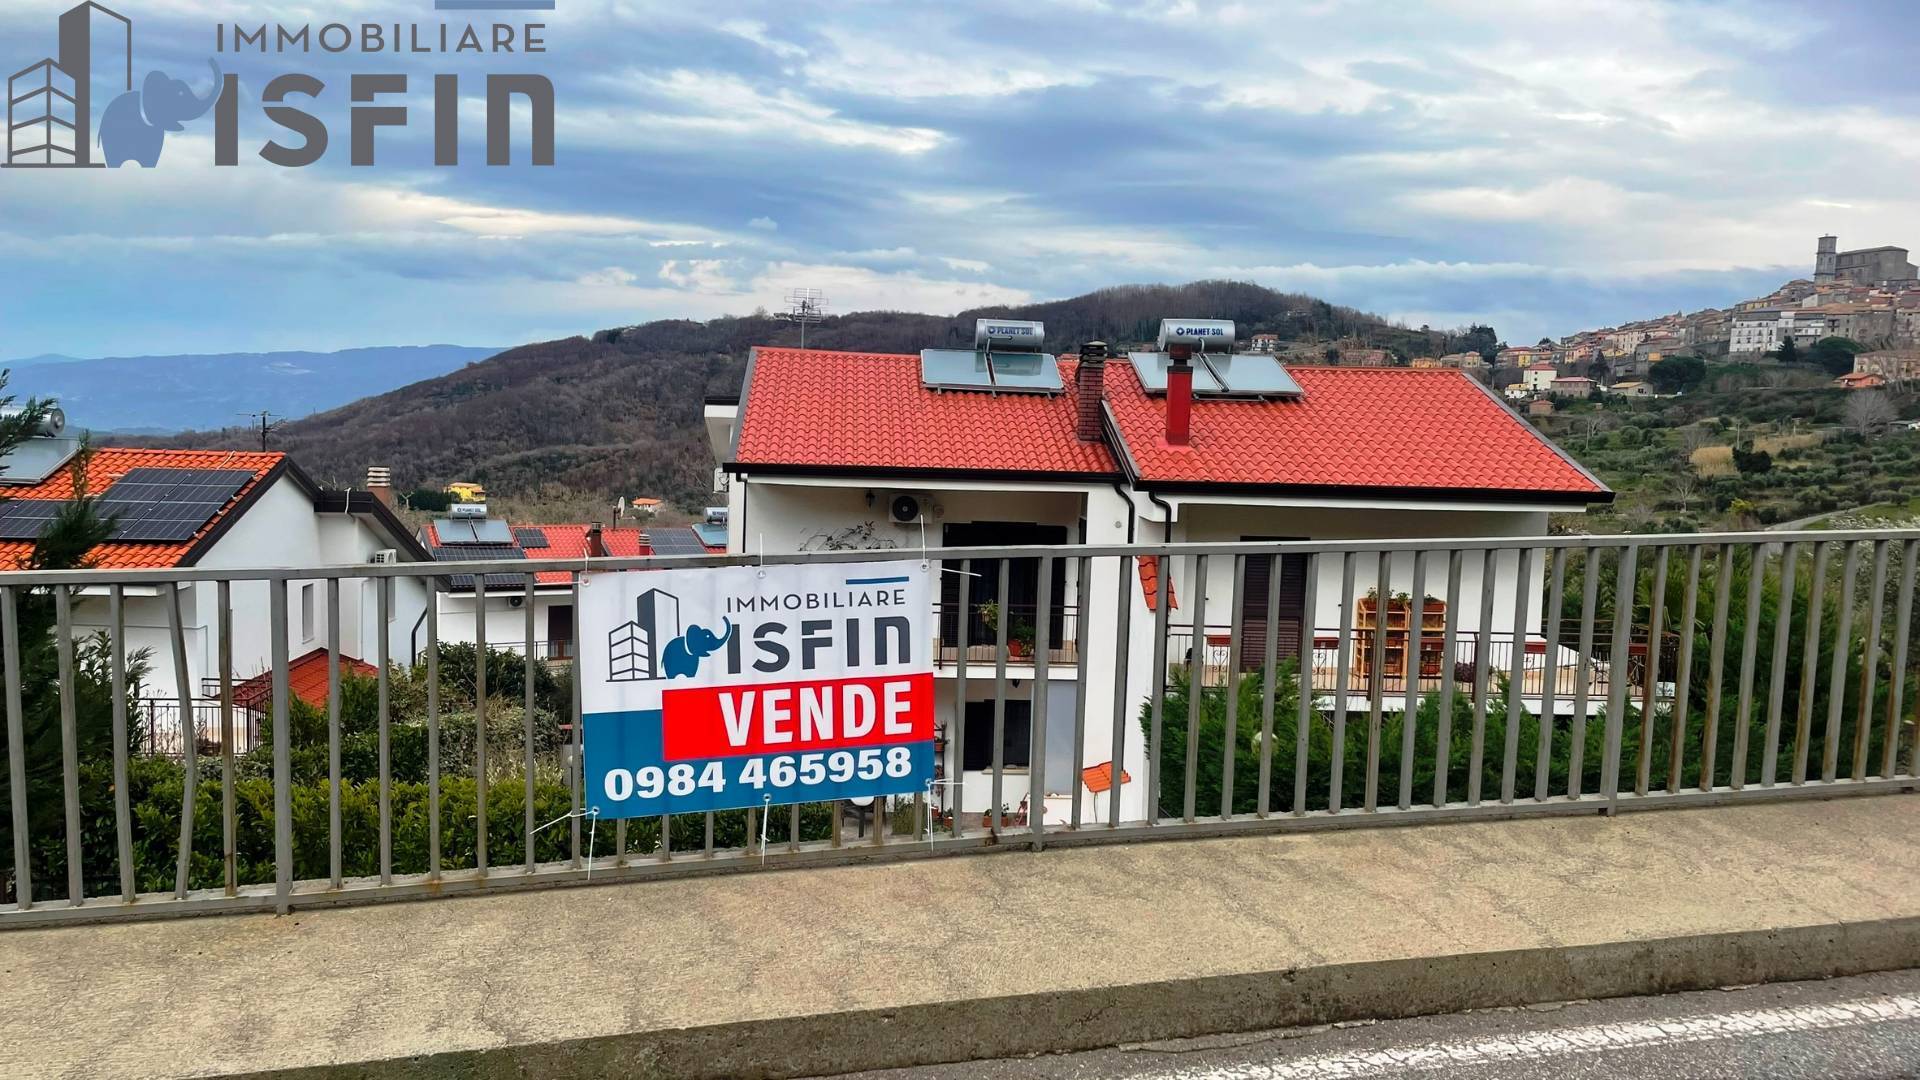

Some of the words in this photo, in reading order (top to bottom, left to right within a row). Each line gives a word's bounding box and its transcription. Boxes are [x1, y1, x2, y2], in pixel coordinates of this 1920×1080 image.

[1186, 327, 1210, 336] PLANET
[1211, 328, 1224, 336] SOL
[727, 589, 906, 613] IMMOBILIARE
[726, 616, 911, 675] ISFIN
[718, 681, 913, 747] VENDE
[604, 761, 726, 802] 0984
[739, 746, 913, 790] 465958
